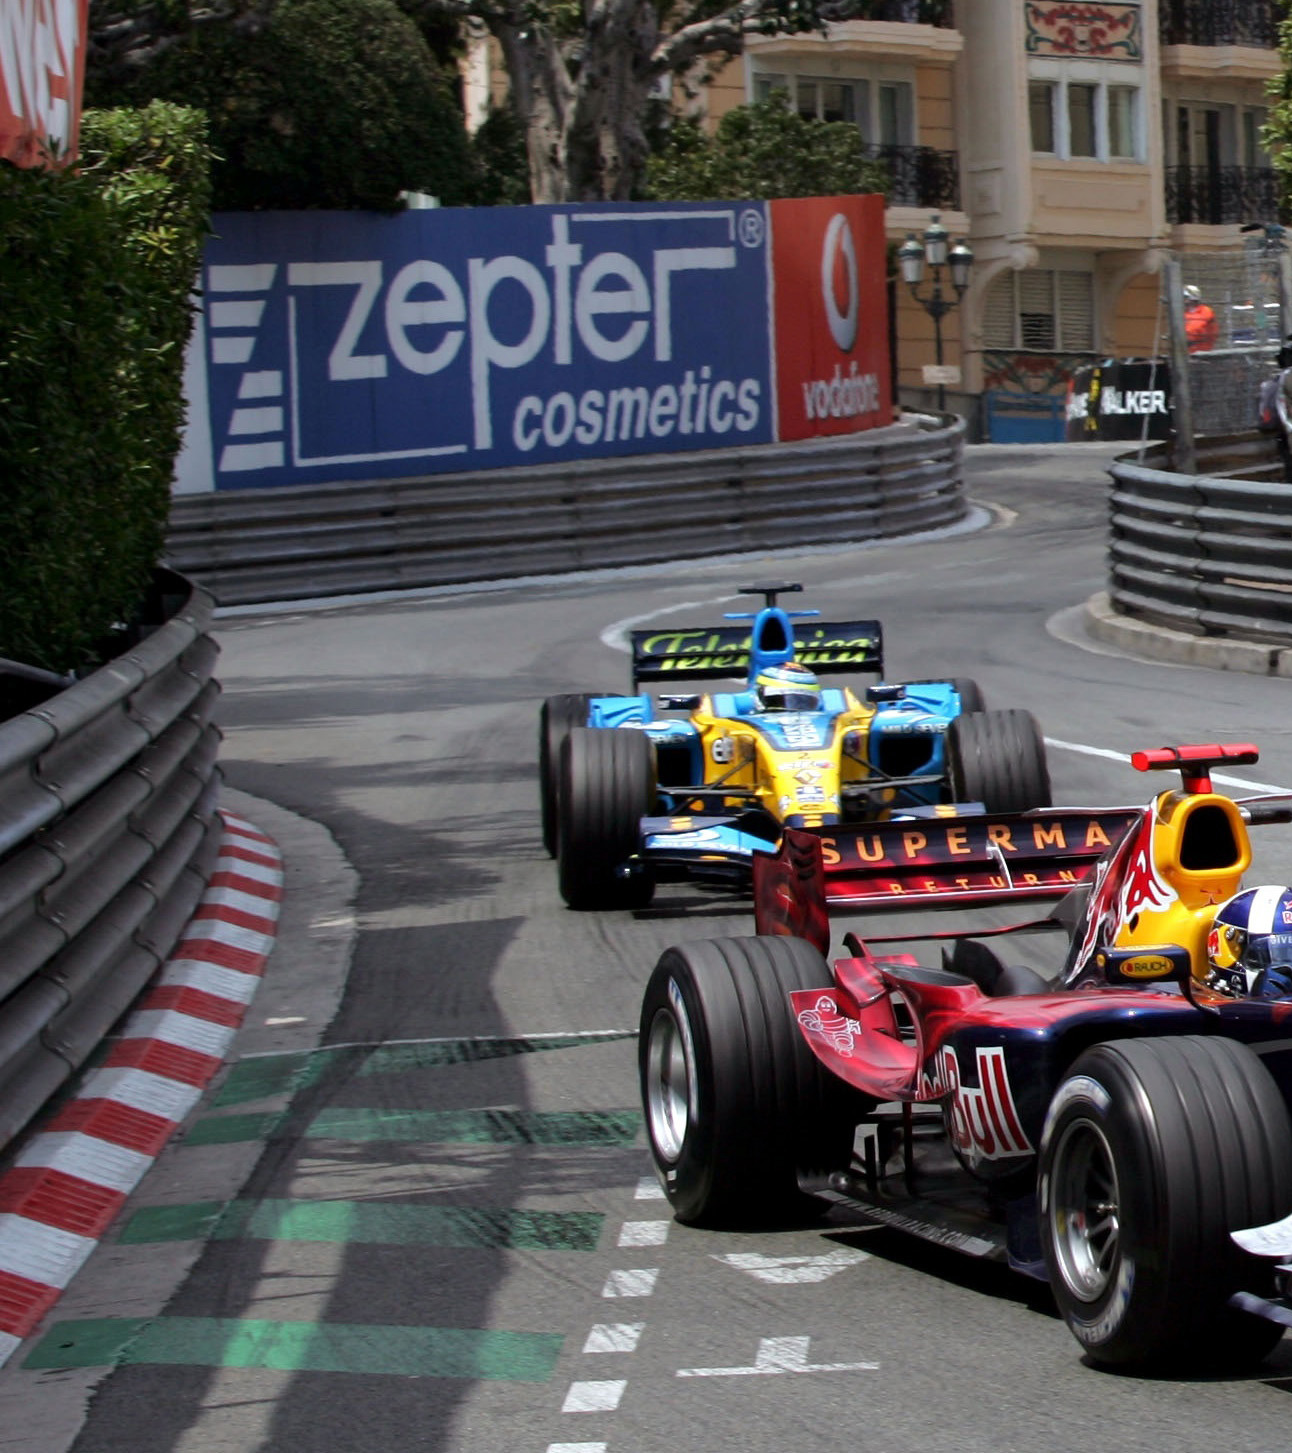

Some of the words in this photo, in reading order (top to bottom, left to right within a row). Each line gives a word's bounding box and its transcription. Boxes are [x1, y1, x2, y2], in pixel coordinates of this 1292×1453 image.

[512, 366, 762, 453] cosmetics
[821, 818, 1133, 865] SUPERMA
[1134, 961, 1168, 972] RAUCH
